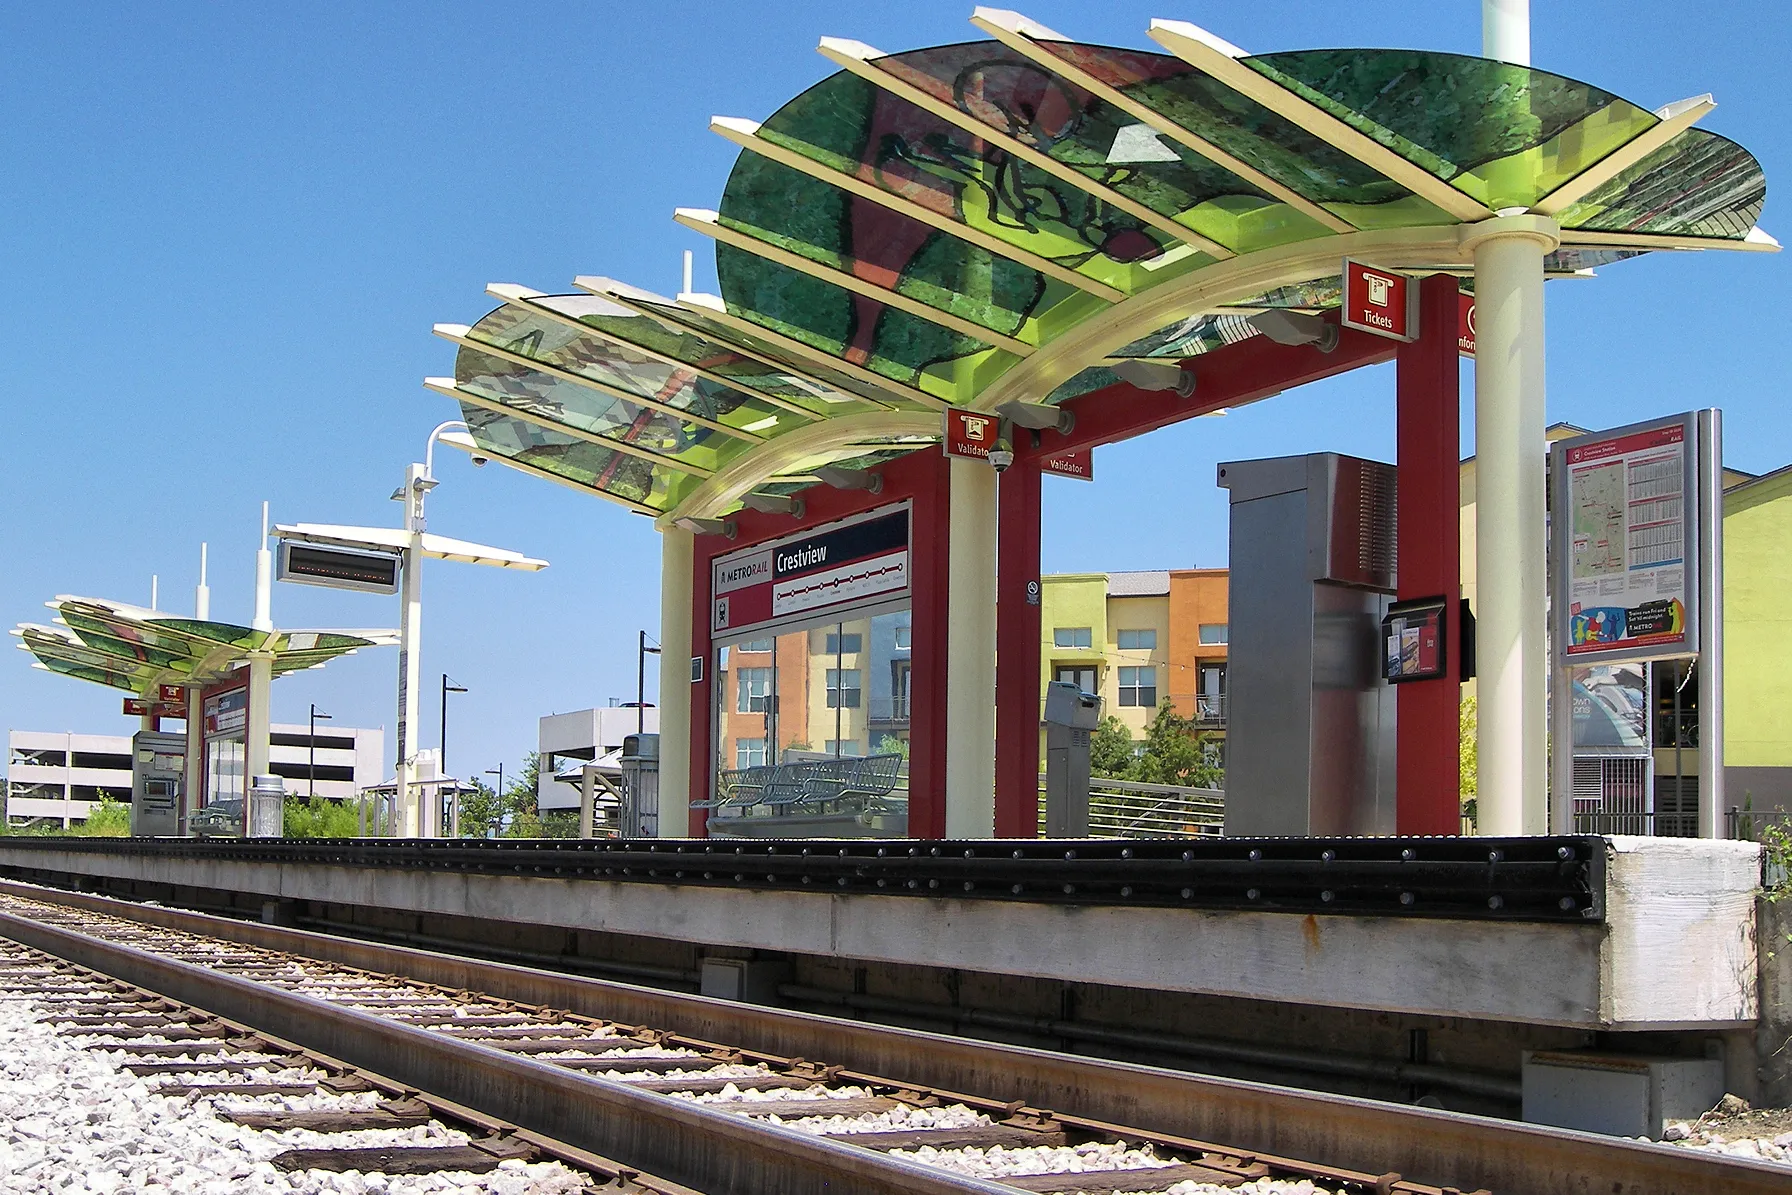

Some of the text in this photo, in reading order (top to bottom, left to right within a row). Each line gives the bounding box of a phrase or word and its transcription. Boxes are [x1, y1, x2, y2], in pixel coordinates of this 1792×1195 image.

[1364, 309, 1393, 329] Tickets
[1458, 335, 1476, 351] nfor
[957, 442, 989, 457] Validato
[1050, 459, 1083, 473] Validator
[777, 544, 827, 572] Crestview
[727, 561, 768, 582] METRORAIL
